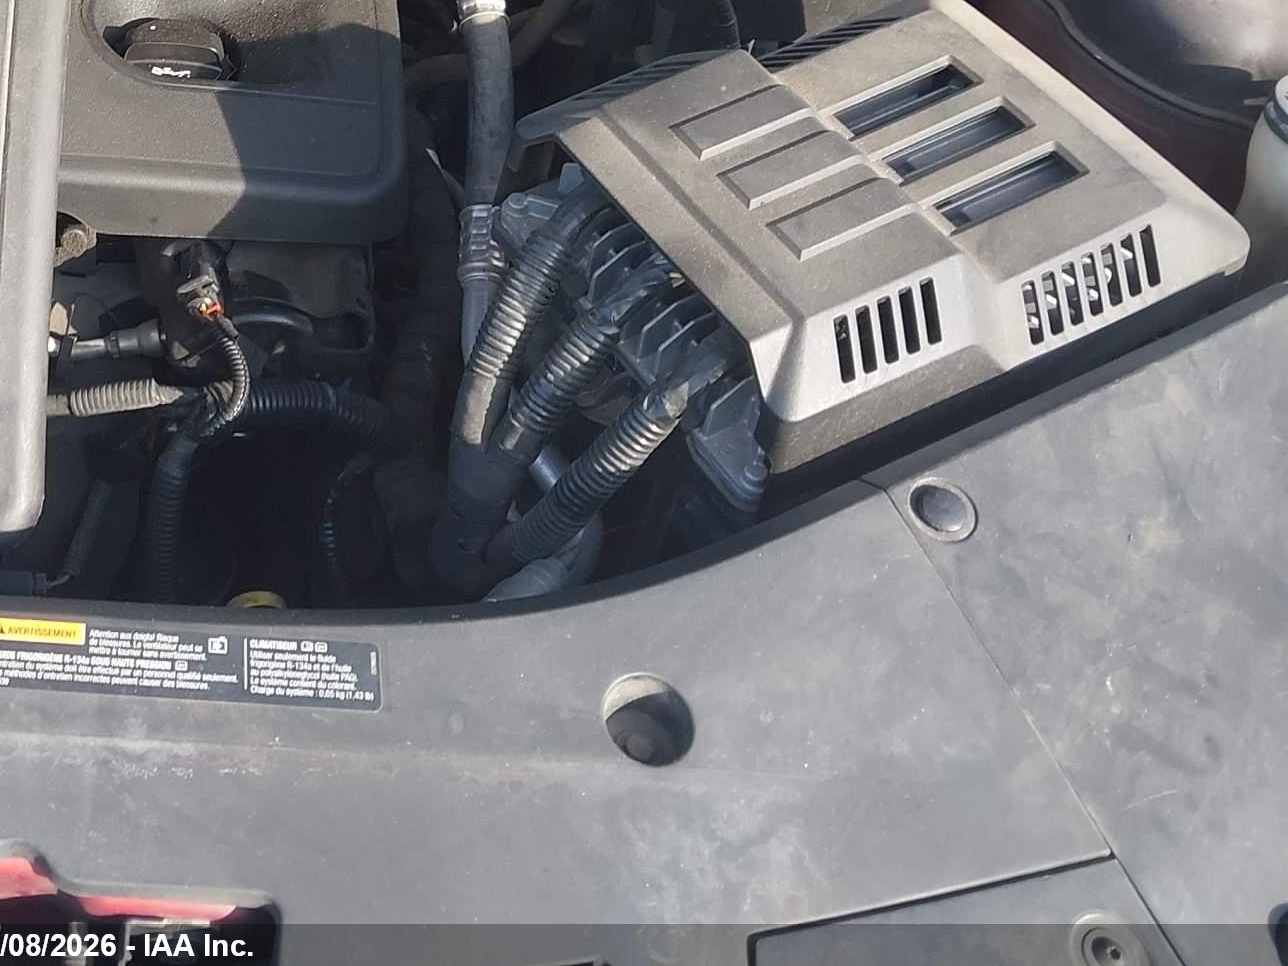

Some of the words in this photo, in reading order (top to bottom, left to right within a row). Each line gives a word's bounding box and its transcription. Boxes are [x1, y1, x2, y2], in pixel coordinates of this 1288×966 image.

[8, 626, 77, 638] AVERTISSEMENT
[89, 629, 119, 639] Attention
[157, 634, 179, 643] Risque
[99, 639, 132, 648] blessures.
[143, 642, 177, 651] ventilateur
[178, 643, 193, 652] peut
[250, 639, 297, 651] CLIMATISEUR
[89, 646, 110, 655] mettre
[118, 648, 141, 657] tourner
[160, 651, 207, 661] avertissement.
[250, 650, 274, 660] Utiliser
[275, 652, 308, 662] seulement
[310, 654, 316, 662] le
[318, 655, 336, 663] fluide
[64, 654, 89, 665] R-134a
[91, 656, 110, 666] SOUS
[111, 657, 134, 668] HAUTE
[136, 659, 171, 670] PRESSION
[287, 662, 312, 671] R-134a
[321, 664, 330, 672] de
[26, 662, 35, 670] du
[64, 664, 77, 673] doit
[120, 668, 132, 677] par
[133, 669, 142, 677] un
[143, 669, 175, 679] personnel
[202, 673, 238, 683] seulement.
[74, 674, 110, 684] incorrectes
[111, 677, 138, 687] peuvent
[139, 678, 161, 687] causer
[163, 680, 175, 688] des
[176, 681, 209, 690] blessures.
[250, 677, 259, 685] Le
[289, 679, 316, 688] contient
[317, 681, 326, 689] du
[328, 682, 357, 691] colorant.
[250, 686, 274, 696] Charge
[276, 687, 284, 695] du
[336, 691, 345, 700] kg
